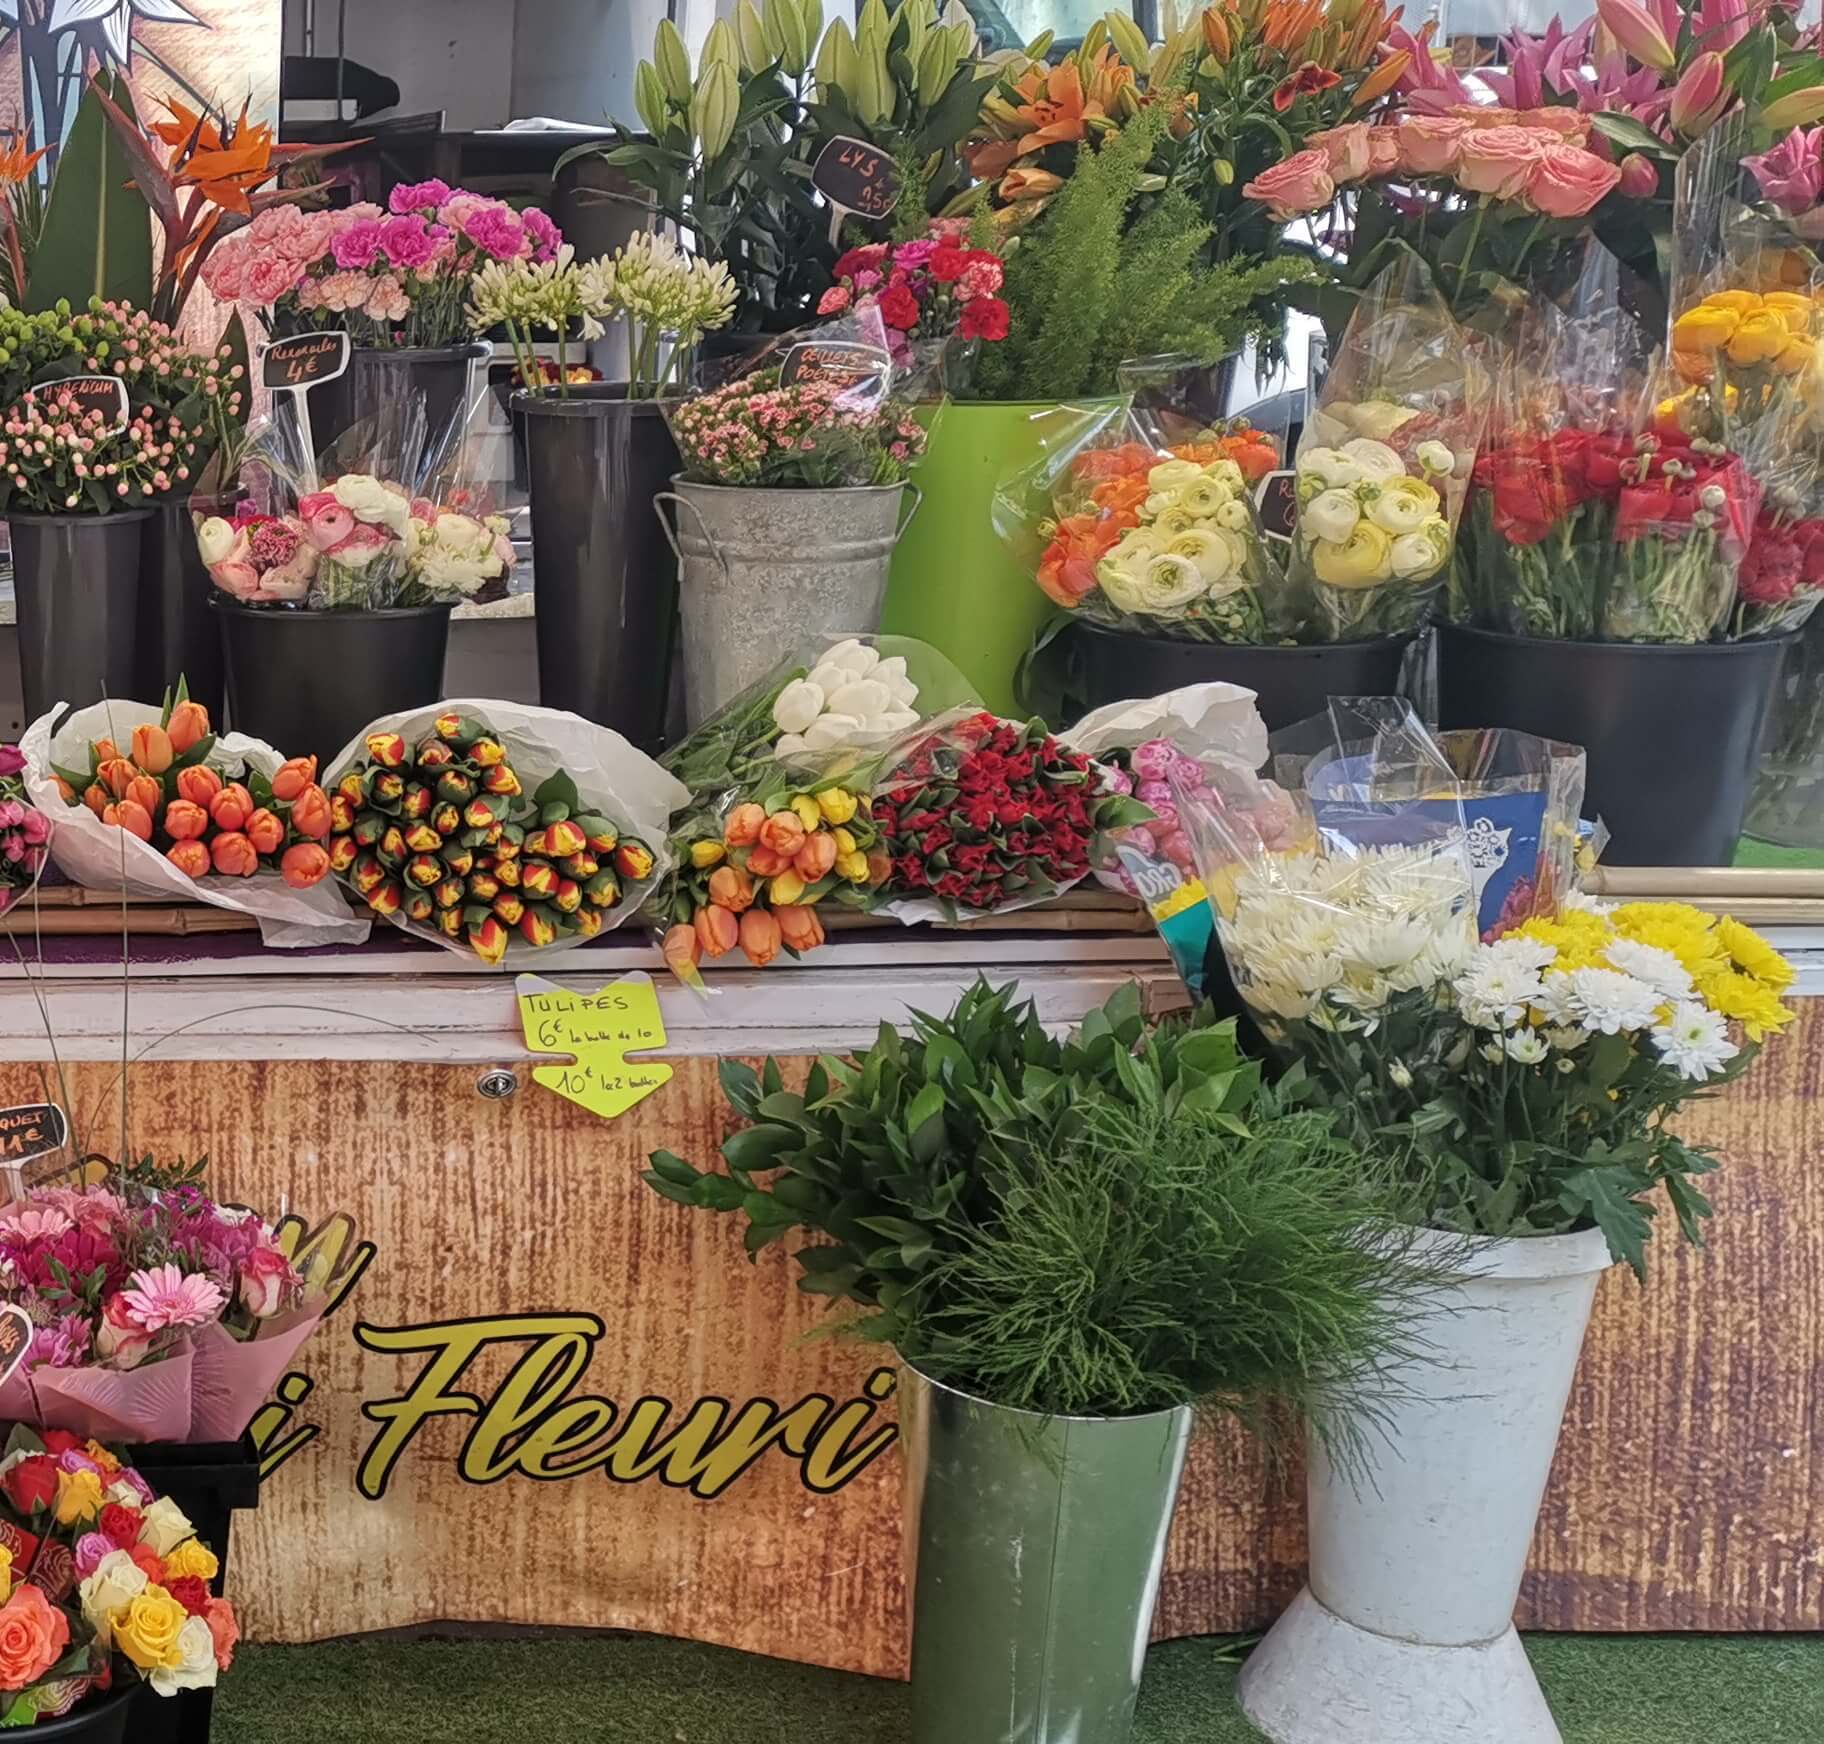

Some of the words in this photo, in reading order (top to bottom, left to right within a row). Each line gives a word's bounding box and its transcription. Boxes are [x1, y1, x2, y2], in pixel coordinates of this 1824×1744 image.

[839, 145, 879, 176] LYS
[286, 355, 319, 382] 4€
[555, 1066, 594, 1094] 10€
[353, 1312, 902, 1500] Fleuri
